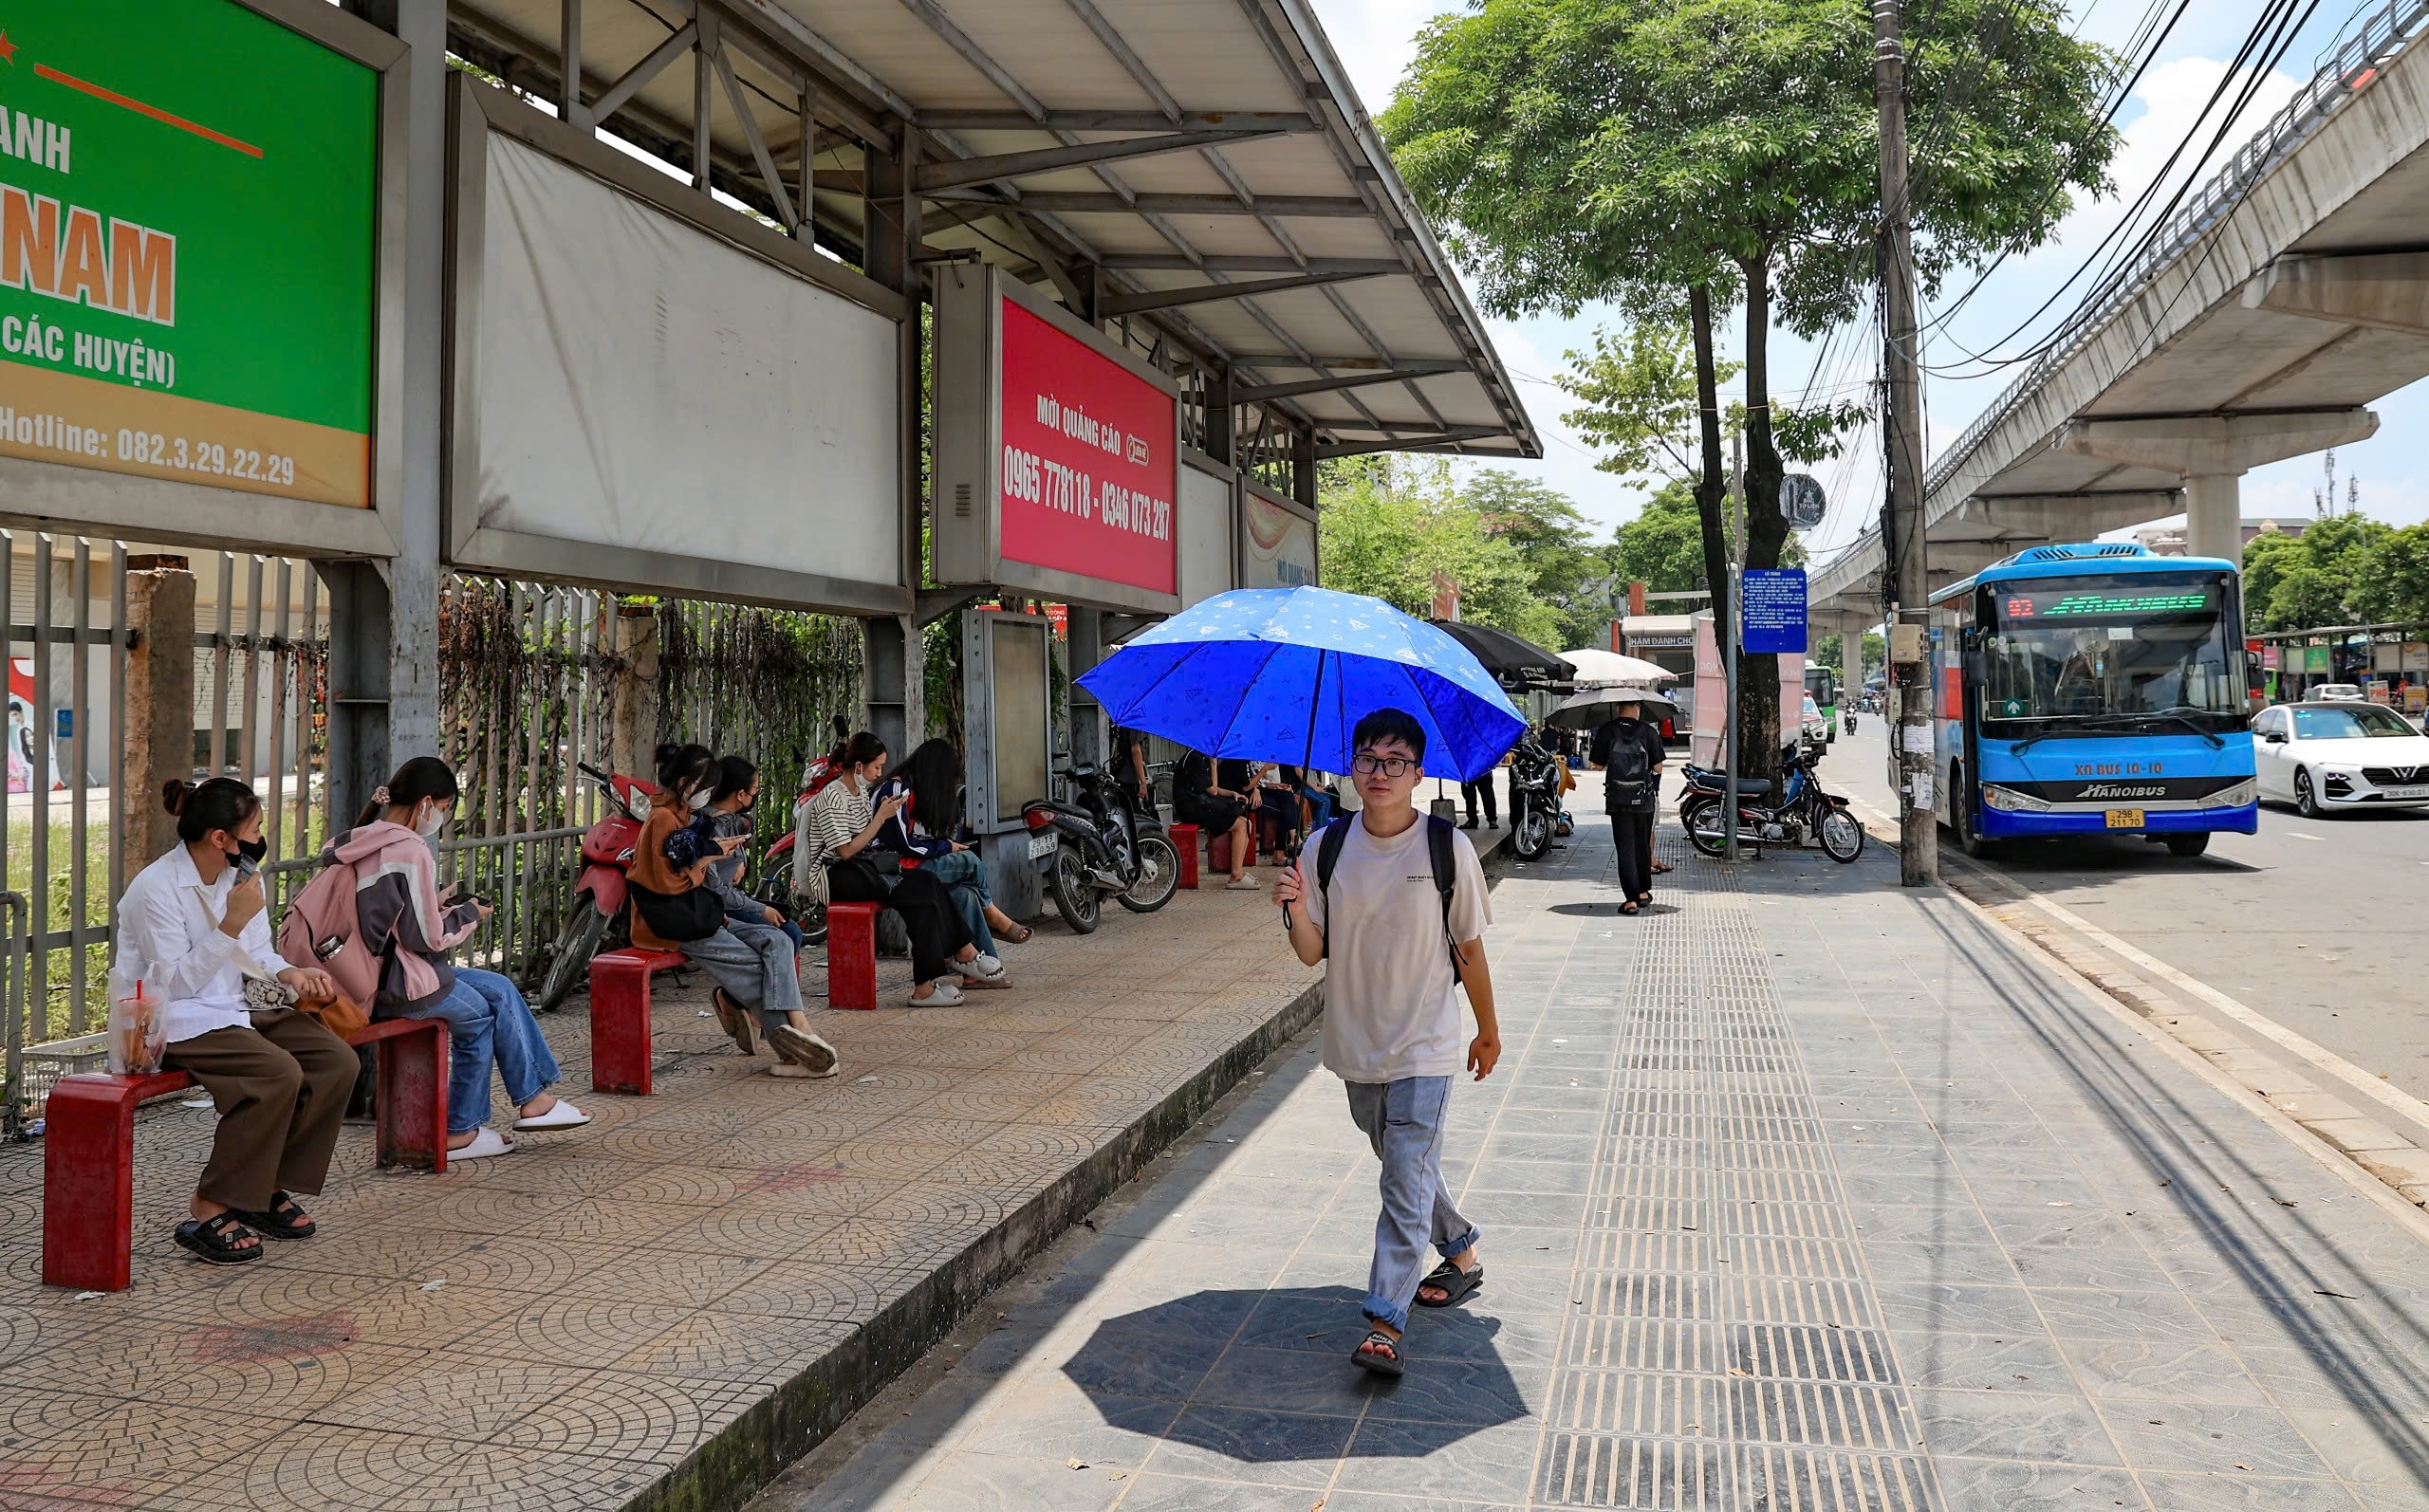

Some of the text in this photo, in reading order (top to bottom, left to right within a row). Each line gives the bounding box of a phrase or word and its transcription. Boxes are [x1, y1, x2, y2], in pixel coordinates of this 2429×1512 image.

[0, 182, 176, 327] NAM
[3, 314, 175, 389] CÁC HUYỆN)
[0, 406, 294, 486] Hotline: 082.3.29.22.29
[1037, 393, 1121, 455] MỜI QUẢNG CÁO
[1004, 444, 1040, 504] 0965
[1044, 459, 1090, 519] 778118
[1102, 480, 1129, 530] 0346
[1131, 490, 1151, 537] 073
[1153, 498, 1170, 542] 287
[2097, 764, 2121, 774] BUS
[2110, 819, 2141, 827] 211.70
[2117, 810, 2133, 819] 29B
